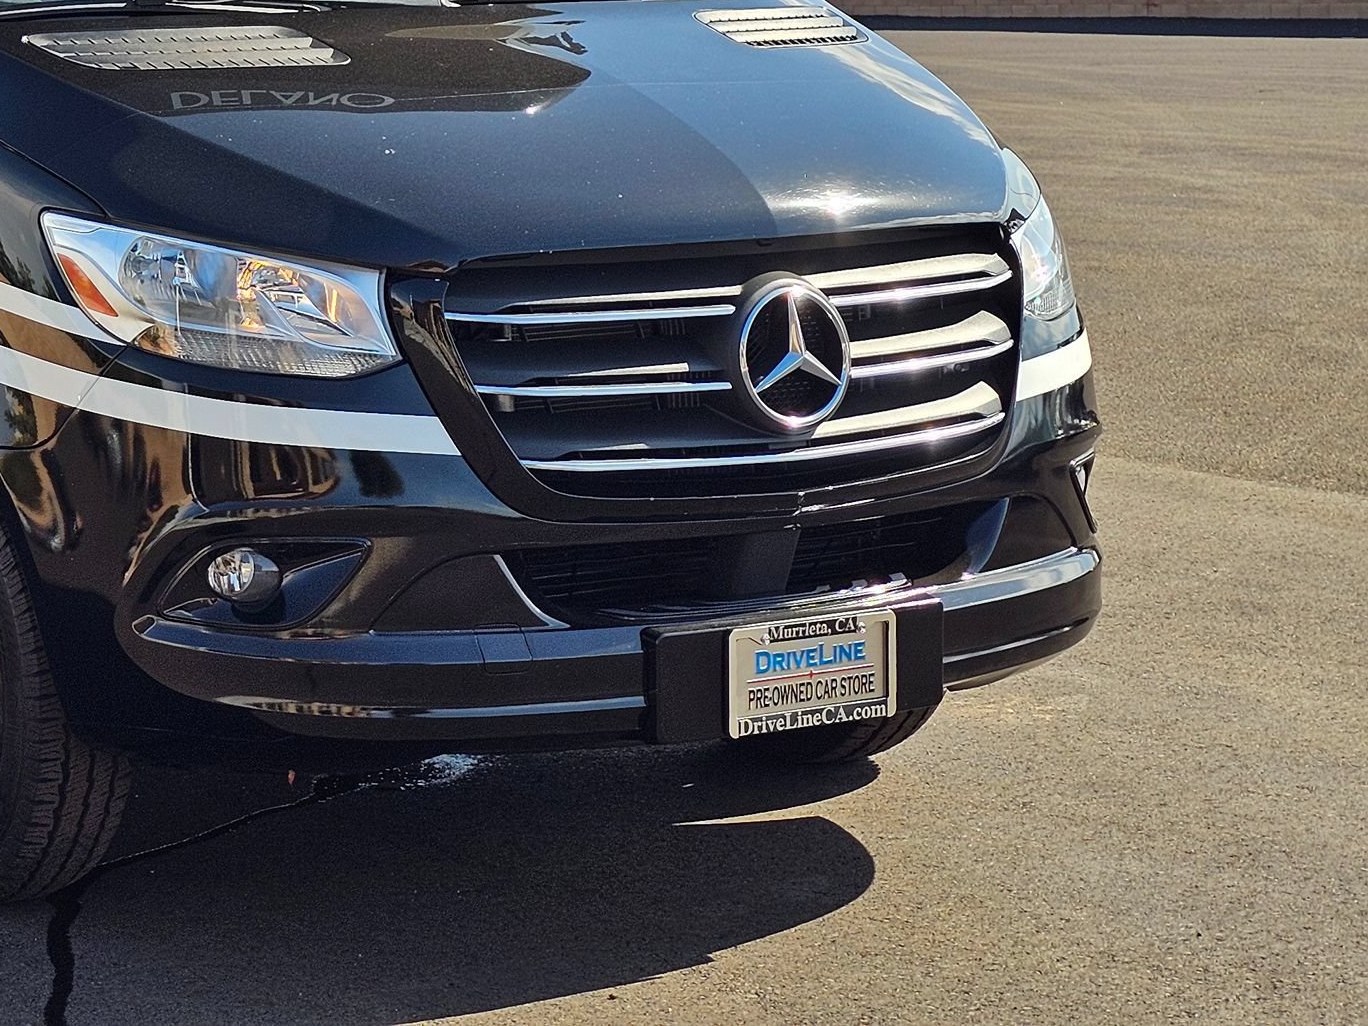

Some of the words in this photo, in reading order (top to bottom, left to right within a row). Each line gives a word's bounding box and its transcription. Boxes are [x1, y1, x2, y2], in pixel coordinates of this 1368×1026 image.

[835, 617, 855, 633] CA
[748, 681, 813, 710] PRE-OWNED
[815, 676, 838, 700] CAR
[839, 672, 876, 698] STORE
[738, 703, 888, 737] DriveLineCA.com
